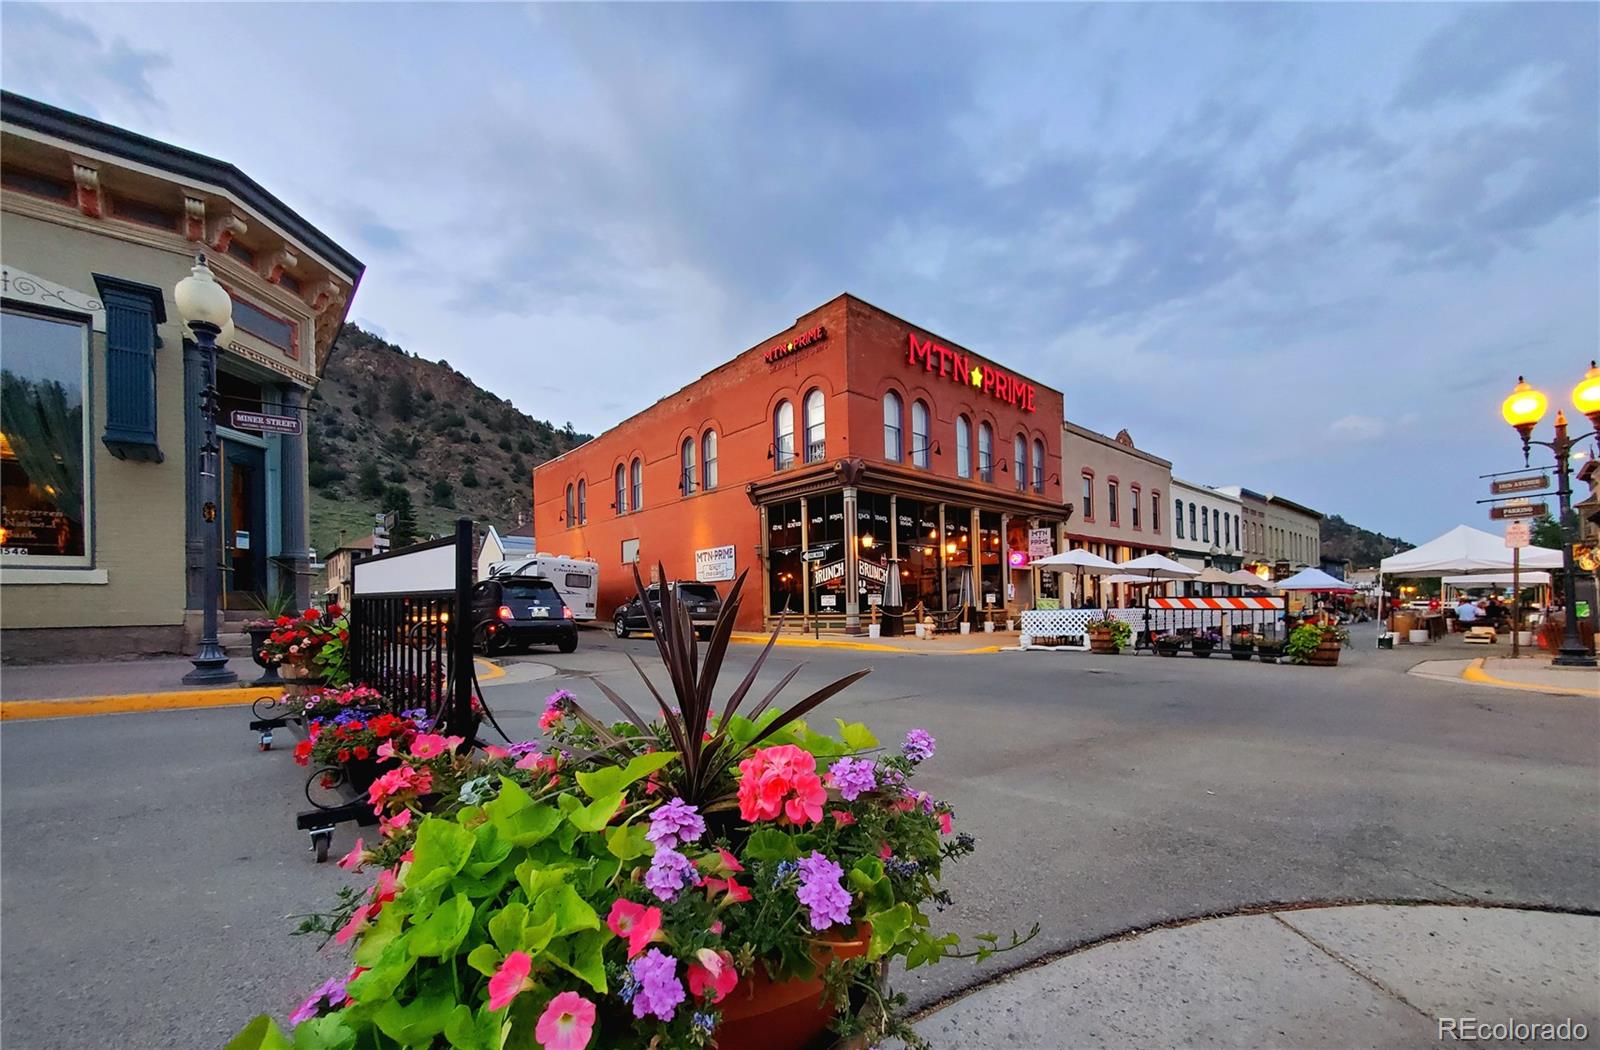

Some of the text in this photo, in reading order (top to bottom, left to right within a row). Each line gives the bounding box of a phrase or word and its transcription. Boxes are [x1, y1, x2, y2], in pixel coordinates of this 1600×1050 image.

[763, 326, 827, 362] MTN PRIME
[908, 333, 1036, 413] MTN PRIME
[236, 414, 264, 424] MINER
[265, 418, 298, 428] STREET
[1503, 506, 1534, 514] PARKING
[1031, 530, 1048, 538] MTN
[696, 547, 734, 563] MTN PRIME
[859, 560, 888, 583] BRUNCH
